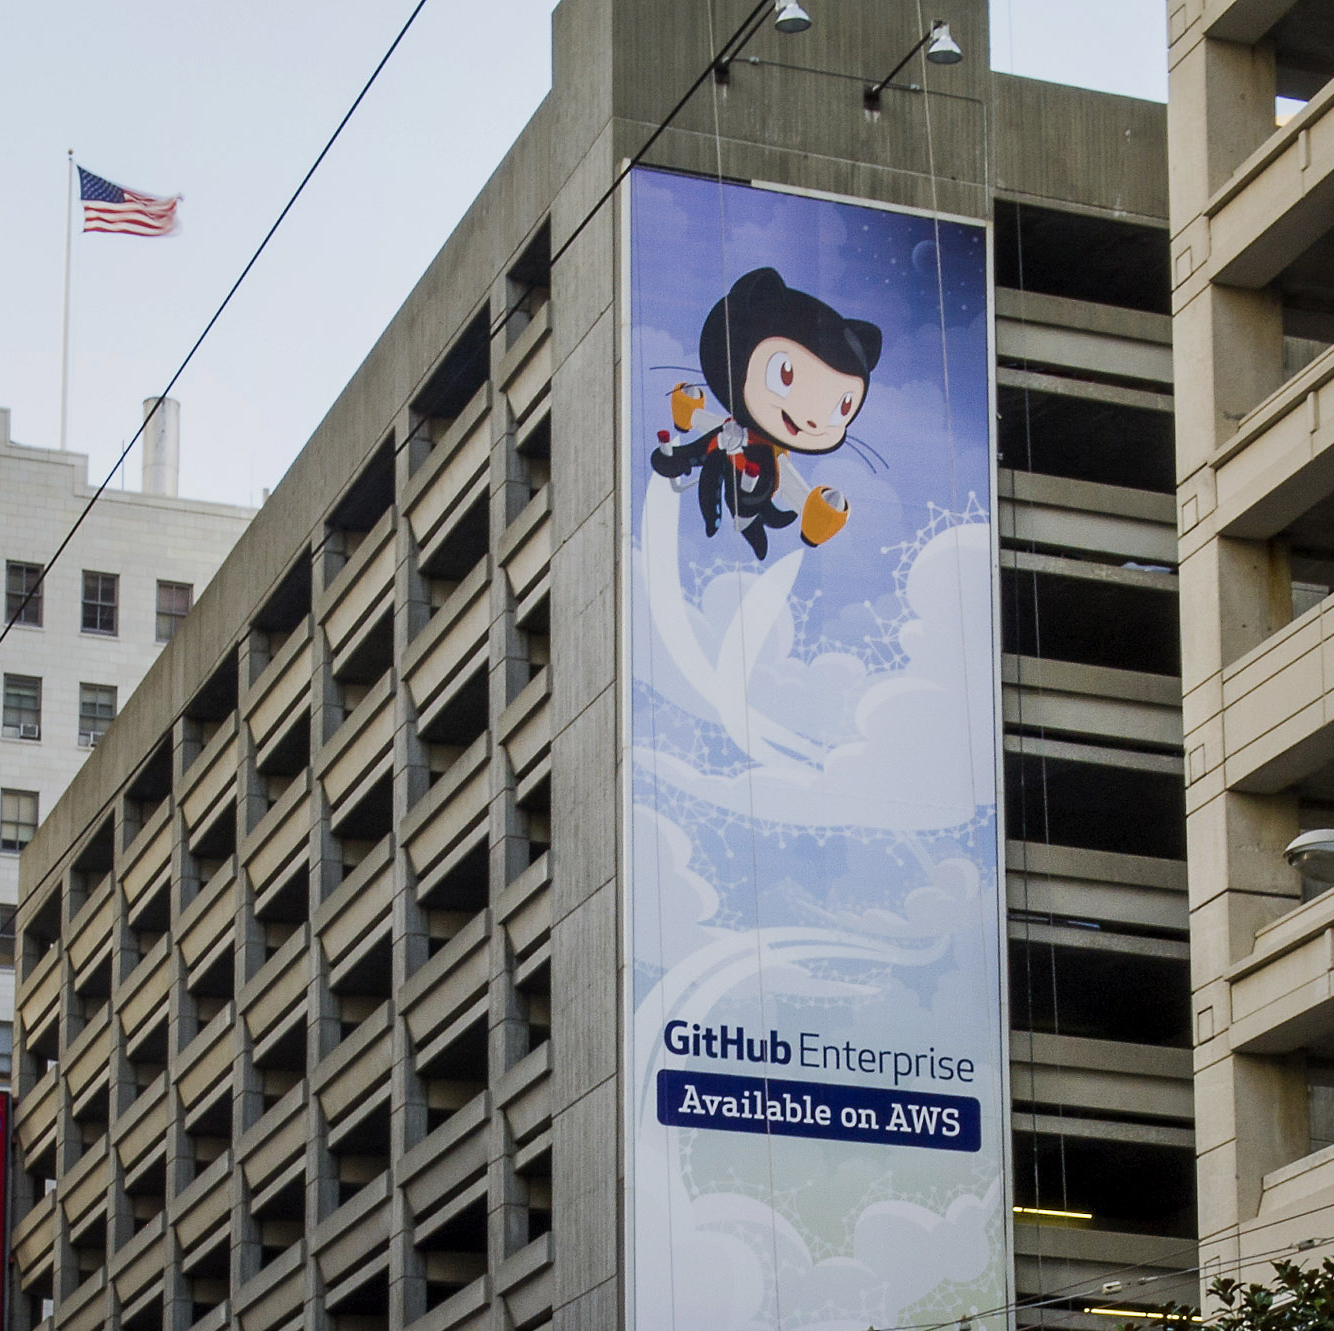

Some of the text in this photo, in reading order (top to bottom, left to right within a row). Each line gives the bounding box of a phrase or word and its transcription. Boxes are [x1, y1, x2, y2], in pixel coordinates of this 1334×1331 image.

[663, 1019, 974, 1086] GitHub Enterprise
[678, 1084, 961, 1138] Available on AWS
